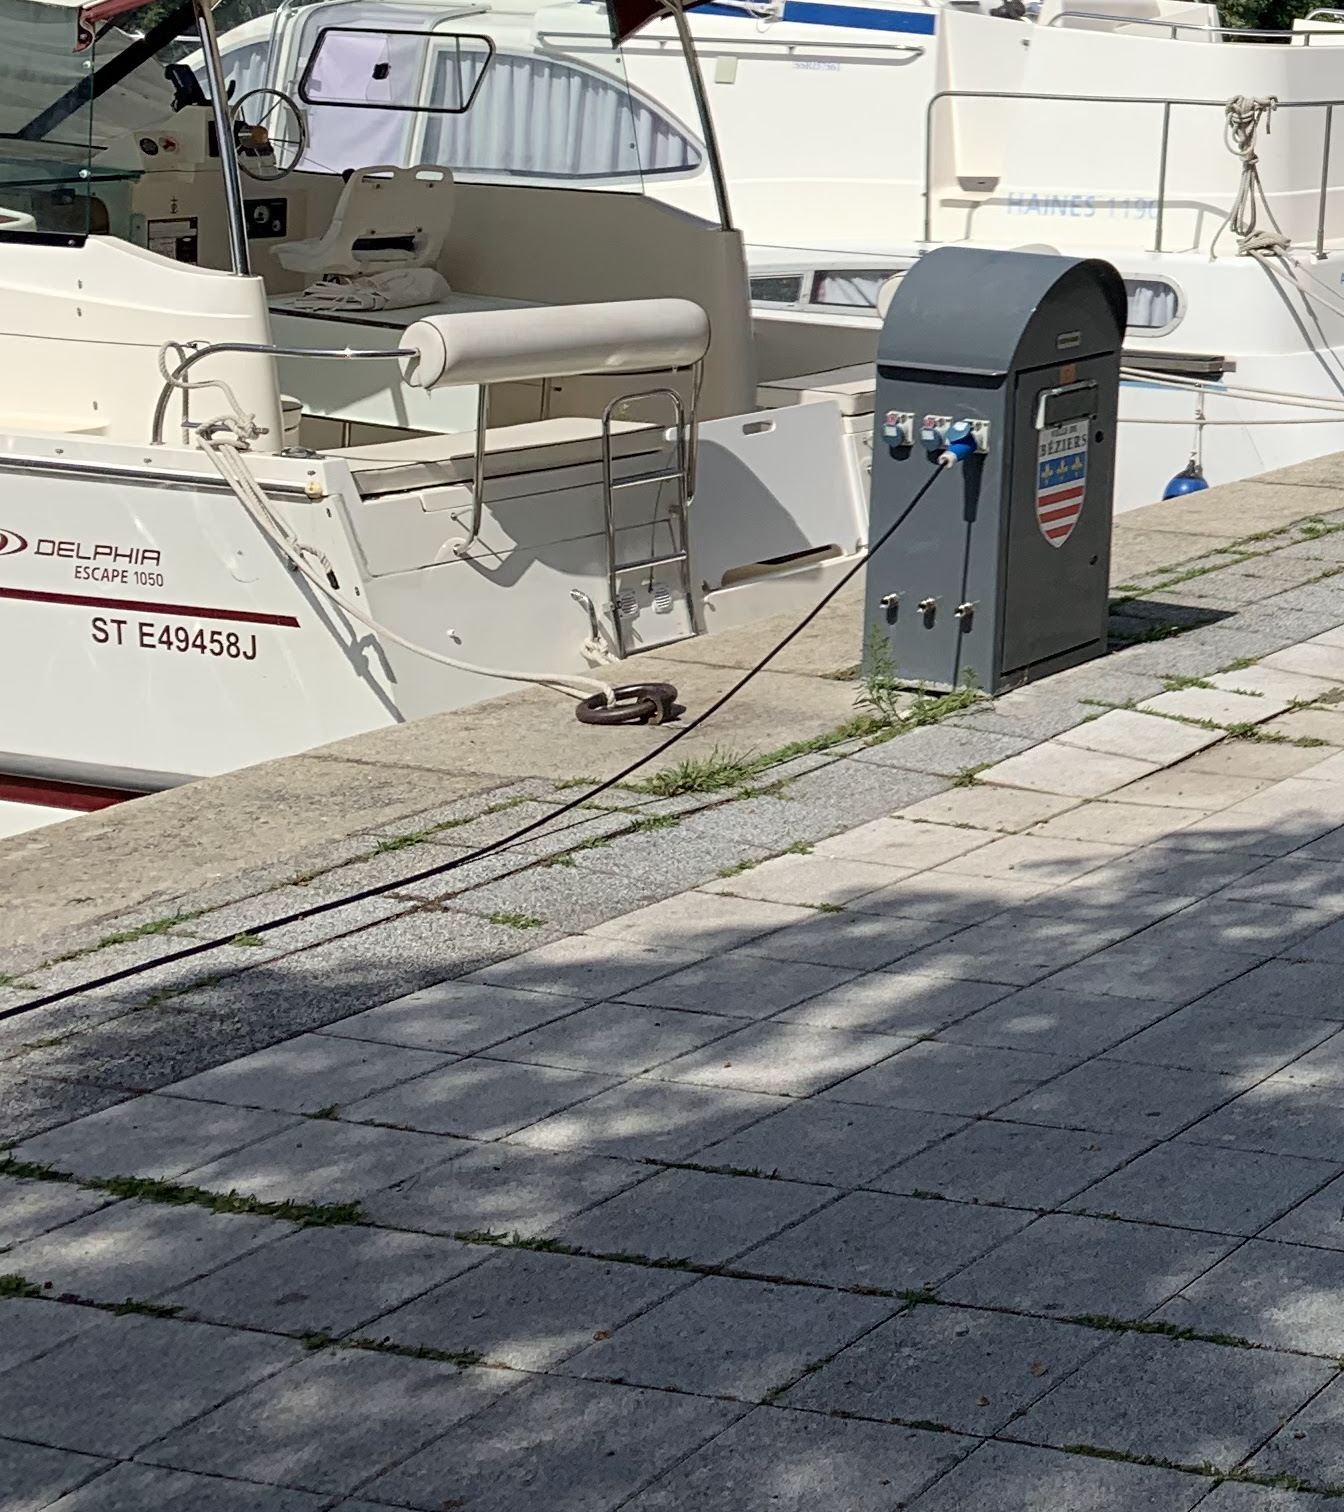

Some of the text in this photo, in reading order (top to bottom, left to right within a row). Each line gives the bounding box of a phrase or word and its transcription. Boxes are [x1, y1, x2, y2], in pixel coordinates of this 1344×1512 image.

[1007, 192, 1096, 217] HAINES
[1039, 434, 1088, 457] BÉZIERS
[34, 538, 161, 567] DELPHIA
[74, 565, 164, 587] ESCAPE 1050
[91, 616, 257, 660] ST E49458J
